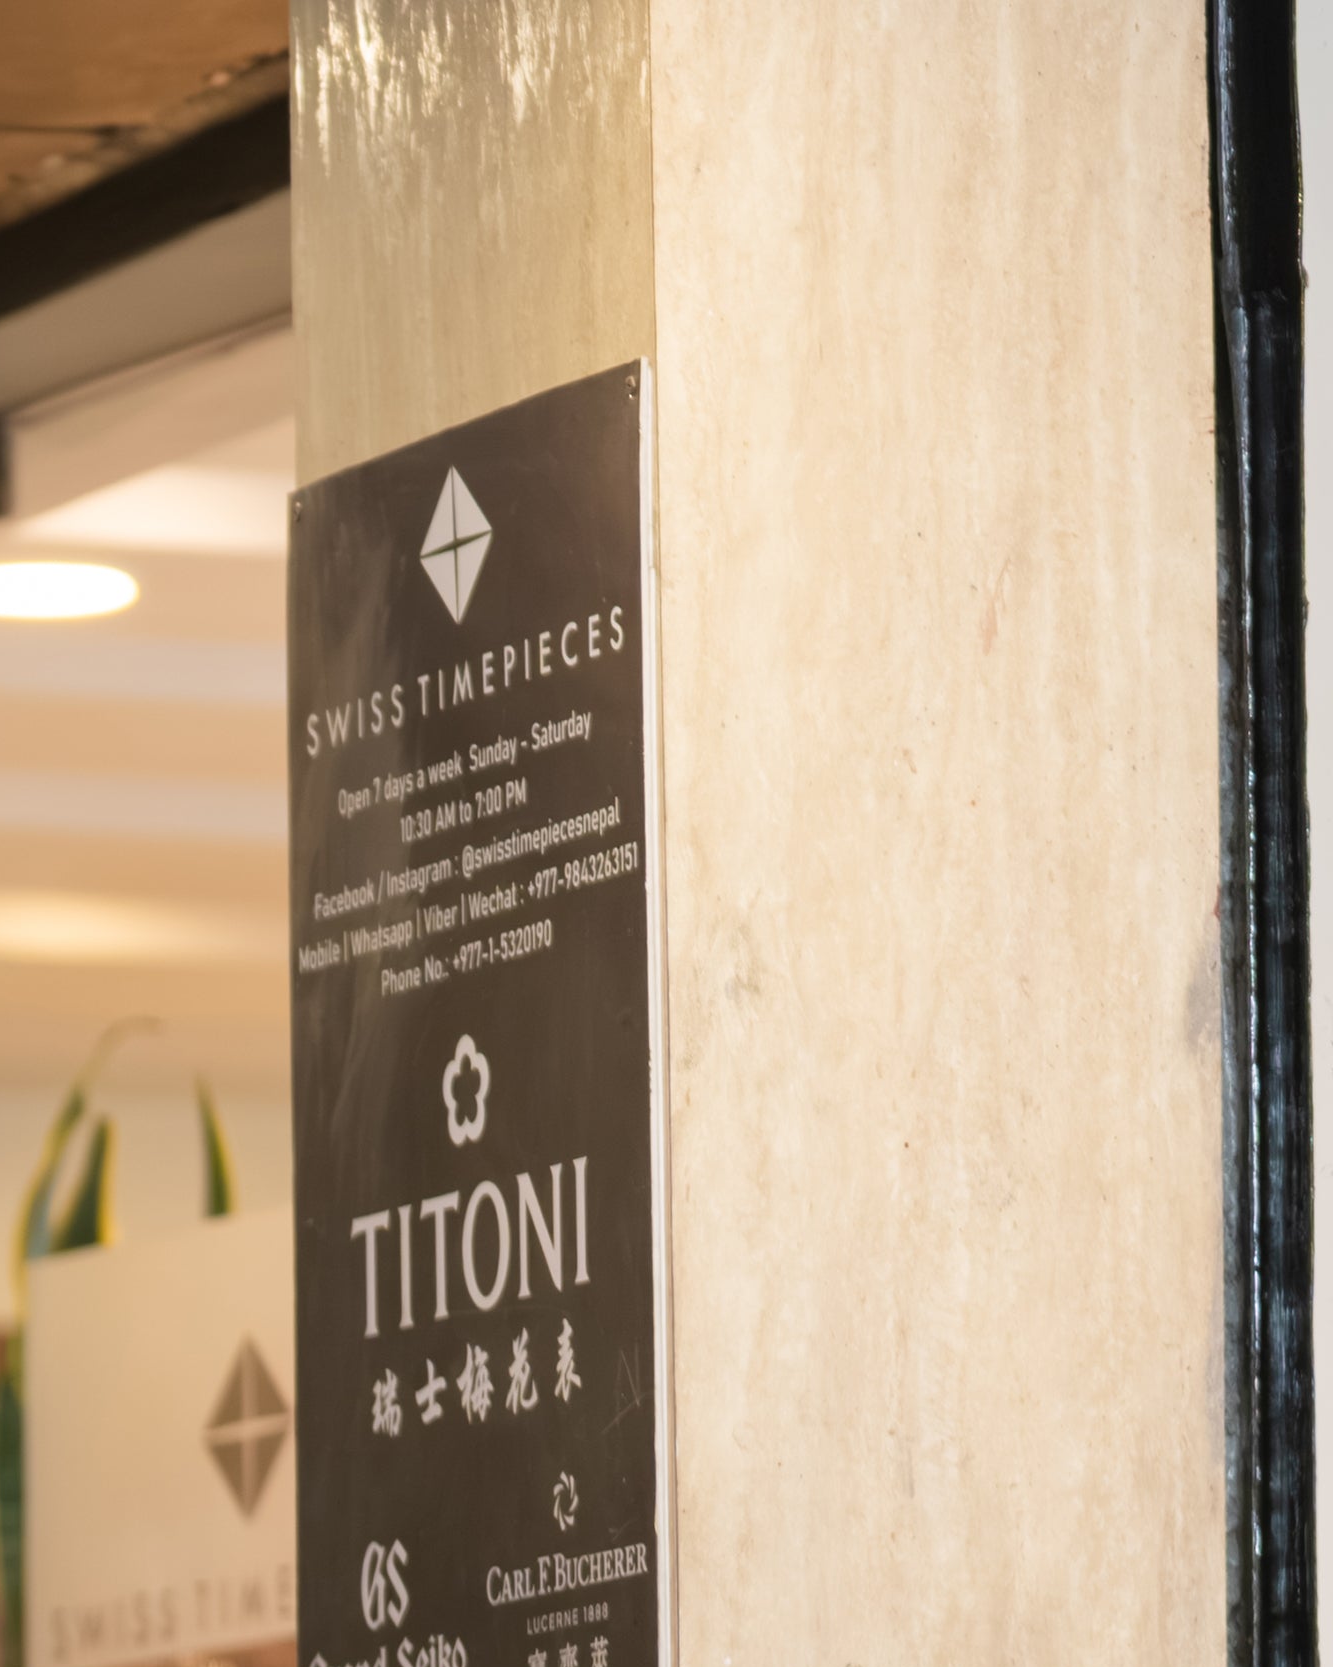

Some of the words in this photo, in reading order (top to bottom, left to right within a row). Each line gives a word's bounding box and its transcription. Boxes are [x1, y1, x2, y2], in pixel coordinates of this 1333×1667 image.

[306, 684, 404, 757] SWISS
[418, 606, 623, 716] TIMEPIECES
[338, 788, 370, 819] Open
[373, 776, 380, 803] 7
[384, 773, 413, 801] days
[417, 769, 424, 789] a
[428, 749, 463, 785] week
[469, 734, 517, 772] Sunday
[531, 710, 592, 751] Saturday
[400, 811, 432, 843] 10:30
[435, 801, 456, 832] AM
[459, 799, 472, 824] to
[475, 784, 502, 819] 7:00
[505, 776, 528, 809] PM
[314, 877, 375, 920] Facebook
[386, 857, 452, 894] Instagram
[462, 795, 621, 880] @swisstimepiecesnepal
[298, 938, 341, 975] Mobile
[350, 922, 413, 957] Whatsapp
[423, 904, 458, 935] Viber
[468, 882, 517, 921] Wechat
[527, 840, 639, 900] +977-9843263151
[381, 966, 421, 996] Phone
[452, 917, 553, 973] +977-1-5320190
[350, 1155, 590, 1339] TITONI
[486, 1565, 535, 1607] CARL
[537, 1555, 551, 1595] F.
[553, 1542, 649, 1592] BUCHERER
[526, 1607, 579, 1636] LUCERNE
[583, 1601, 609, 1623] 1888
[52, 1585, 177, 1665] SWISS
